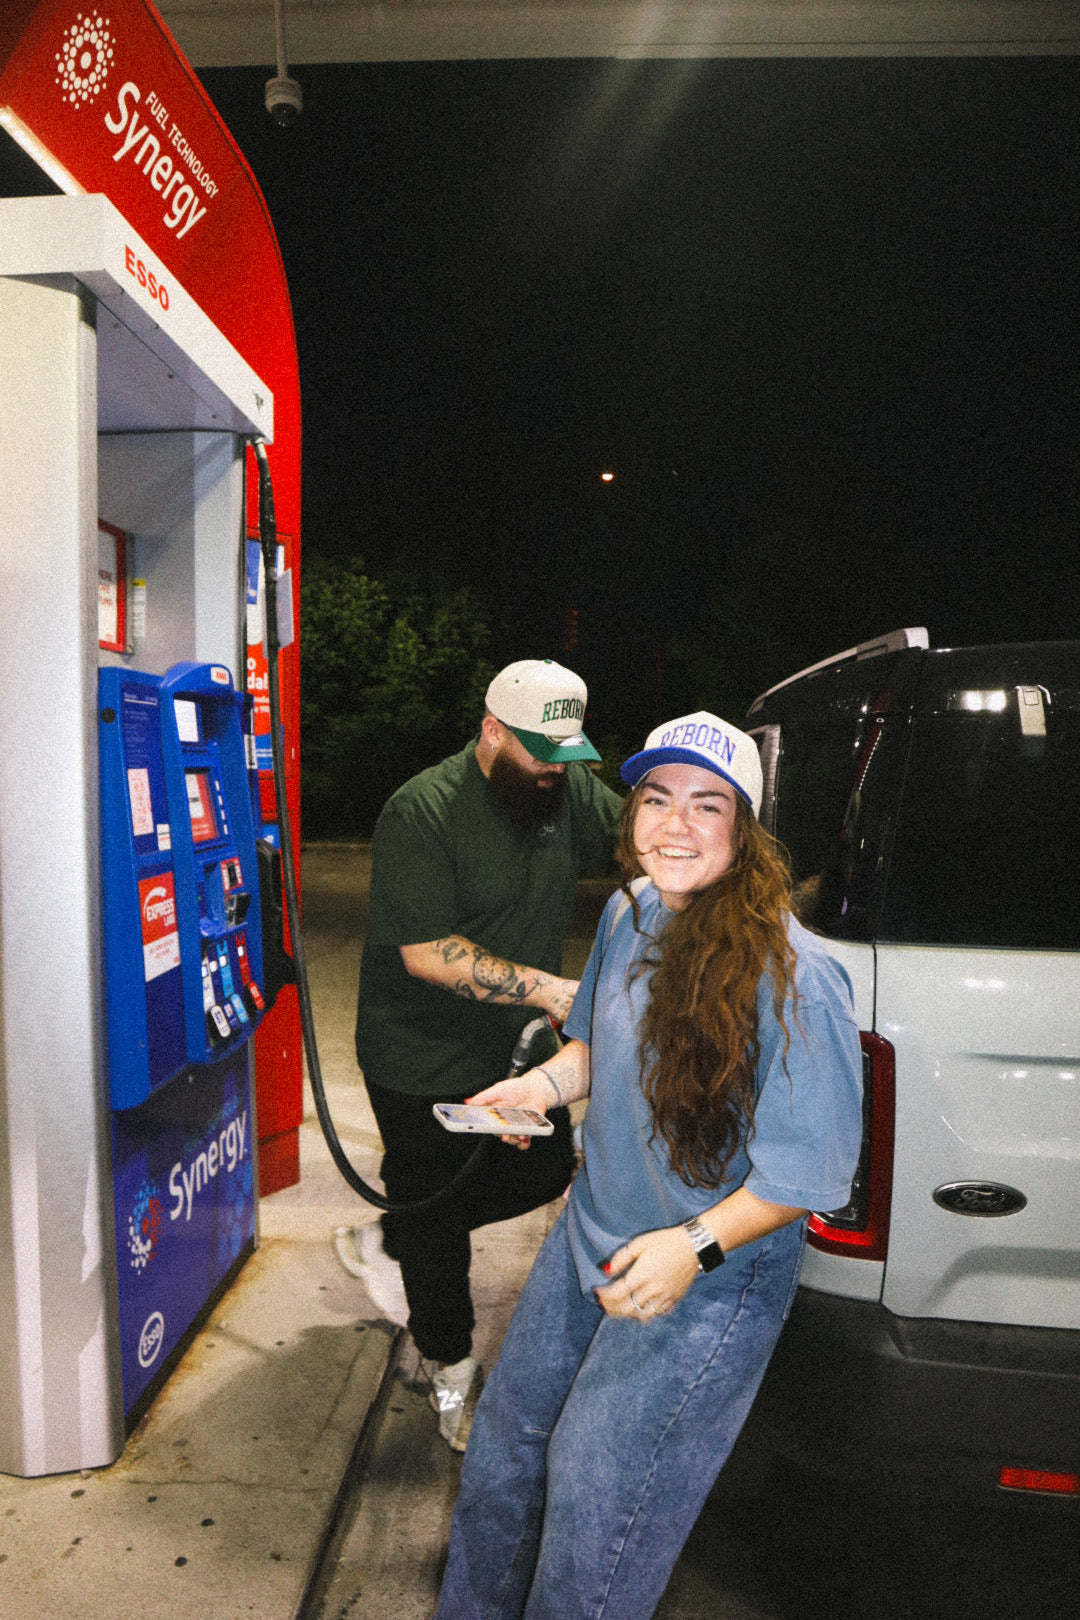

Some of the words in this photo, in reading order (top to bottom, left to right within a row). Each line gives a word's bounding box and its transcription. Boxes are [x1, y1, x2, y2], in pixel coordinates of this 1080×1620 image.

[104, 81, 207, 239] Synergy
[145, 90, 168, 131] FUEL
[168, 122, 219, 199] TECHNOLOGY
[125, 244, 169, 311] ESSO
[660, 723, 736, 766] REBORN
[169, 1110, 247, 1221] Synergy
